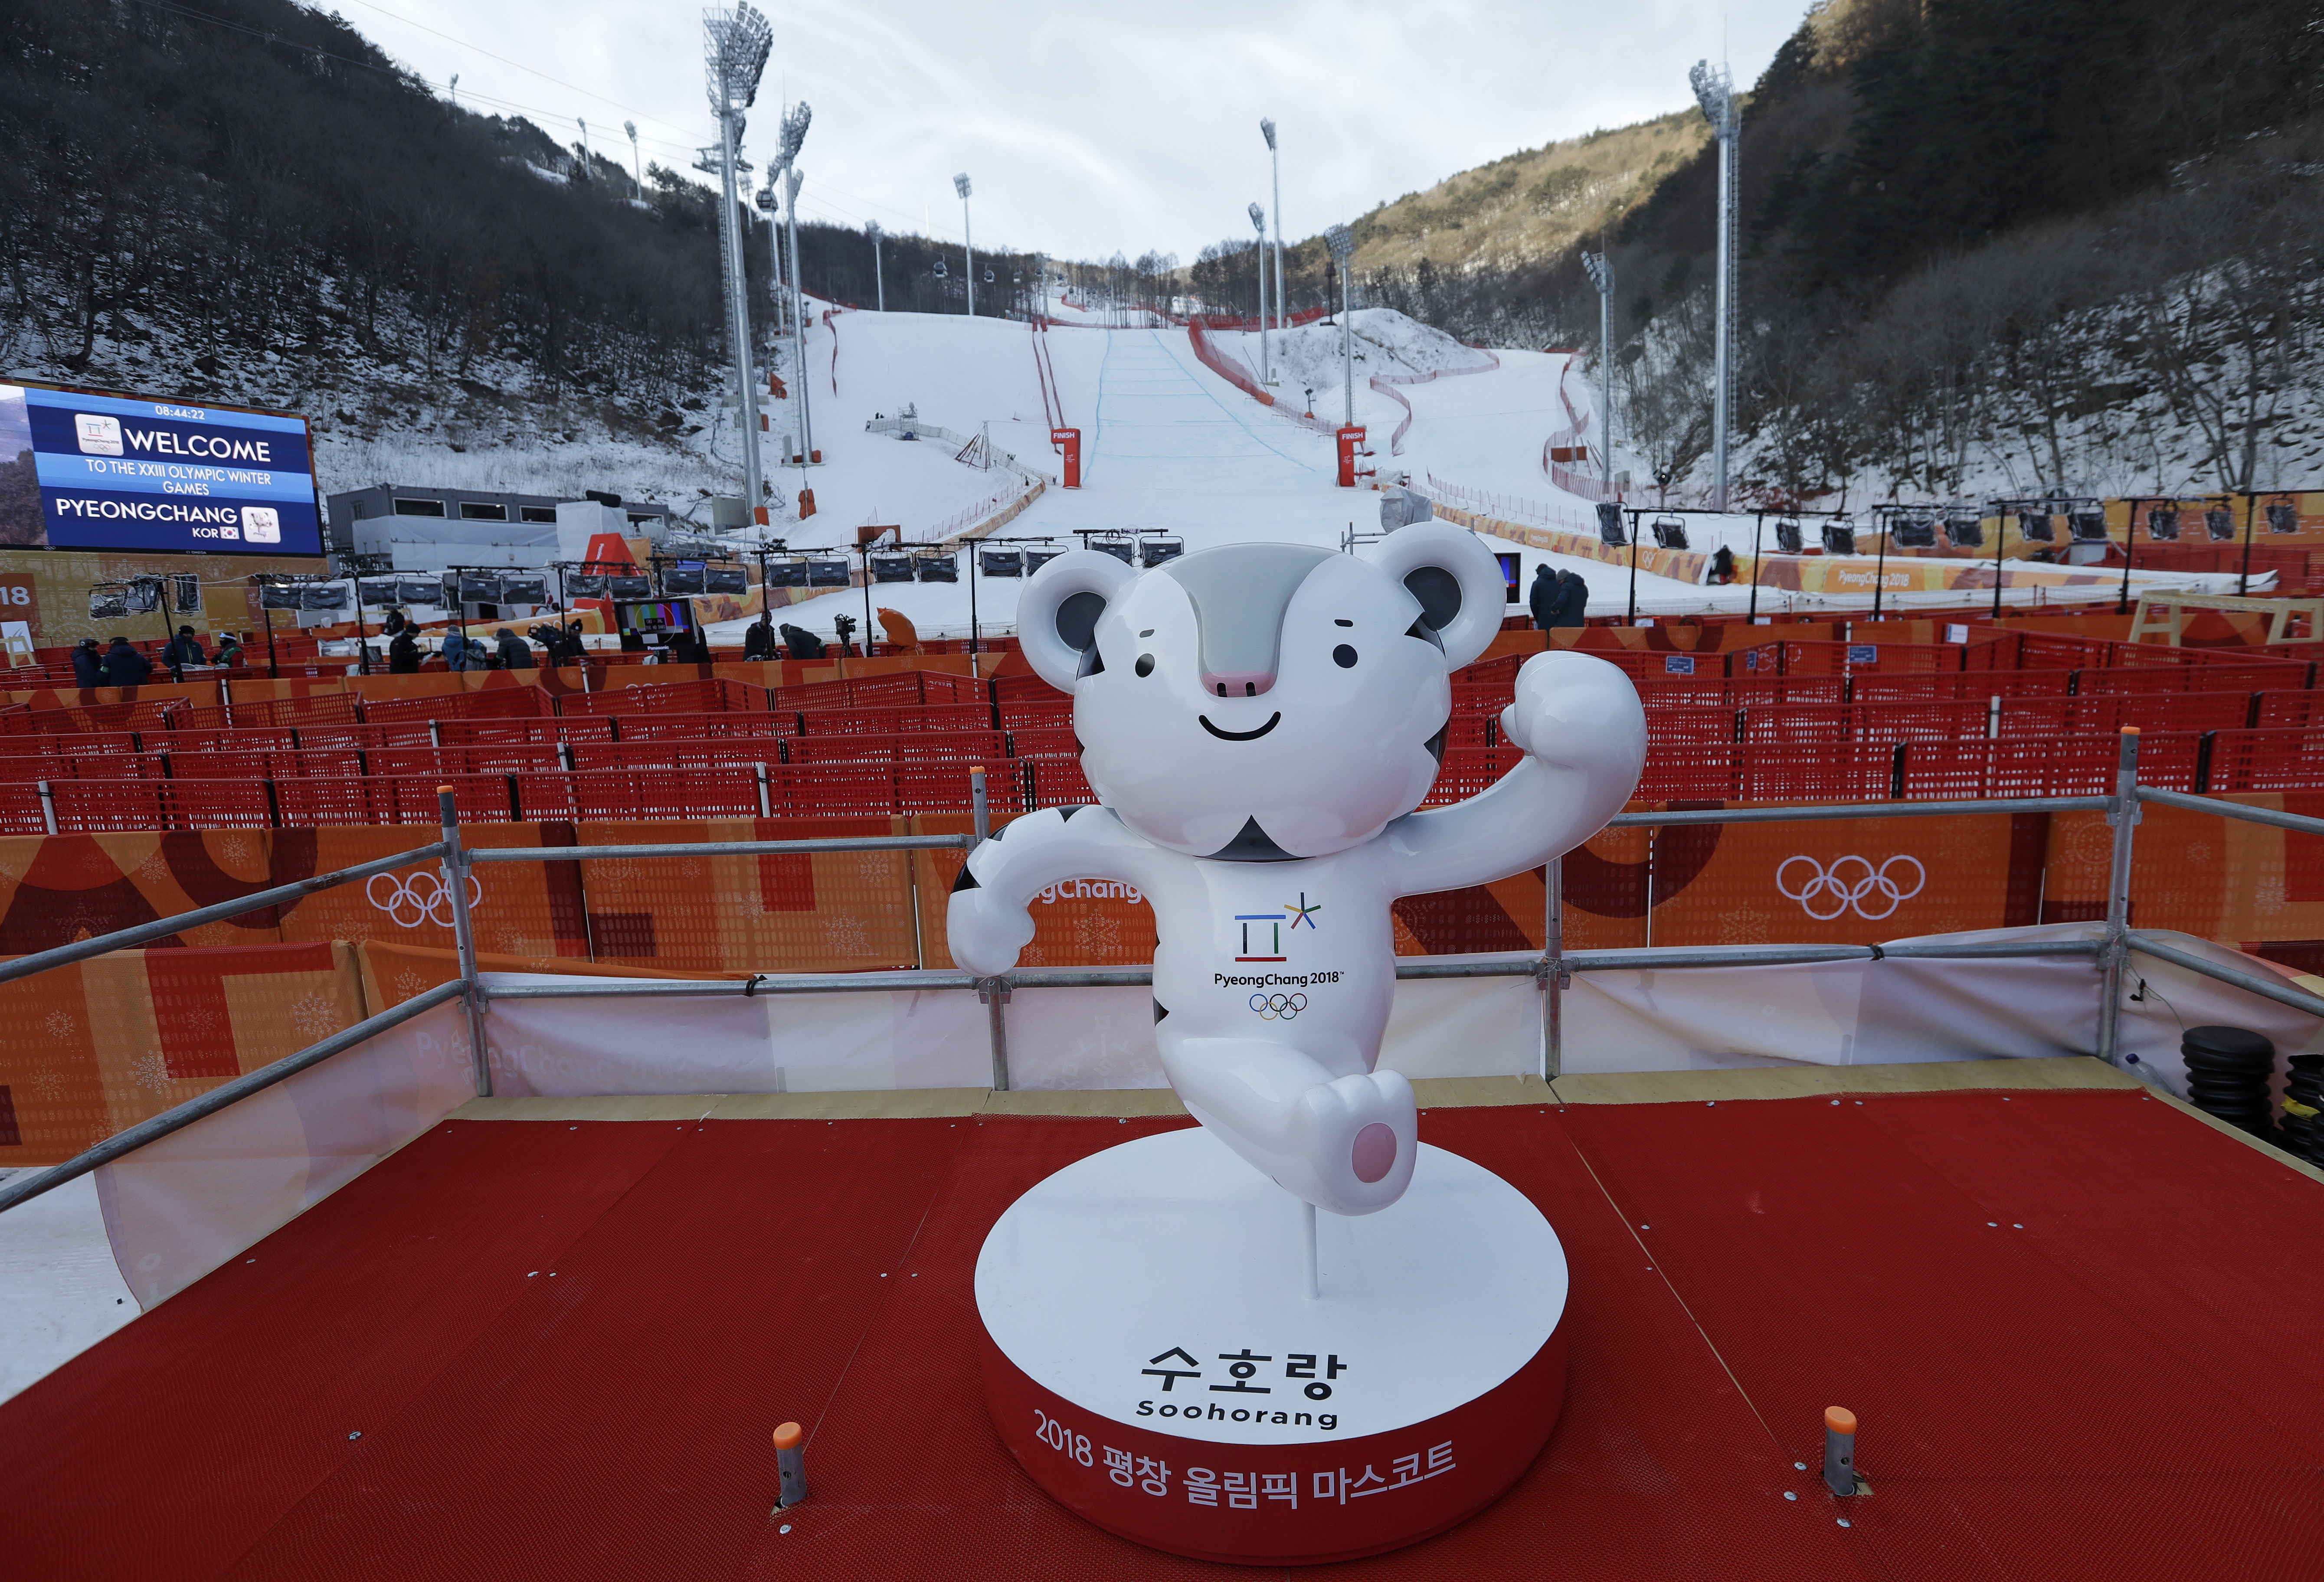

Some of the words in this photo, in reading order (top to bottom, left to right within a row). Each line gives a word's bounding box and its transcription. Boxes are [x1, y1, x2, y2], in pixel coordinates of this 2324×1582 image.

[155, 405, 206, 420] 08:44:22
[124, 428, 271, 462] WELCOME
[85, 459, 107, 473] TO
[109, 461, 135, 475] THE
[138, 463, 166, 477] XXIII
[168, 465, 226, 482] OLYMPIC
[227, 470, 272, 485] WINTER
[163, 481, 209, 496] GAMES
[56, 498, 238, 524] PYEONGCHANG
[192, 527, 219, 539] KOR
[1890, 573, 1910, 587] 2018
[0, 586, 30, 605] 18
[1034, 879, 1142, 904] gChang
[1214, 973, 1308, 988] PyeongChang
[1141, 1346, 1347, 1401] 수호랑
[1136, 1400, 1337, 1430] Soohorang
[1034, 1409, 1093, 1468] 2018
[1102, 1444, 1172, 1497] 평창
[1183, 1467, 1298, 1510] 올림픽
[1313, 1440, 1456, 1506] 마스코트
